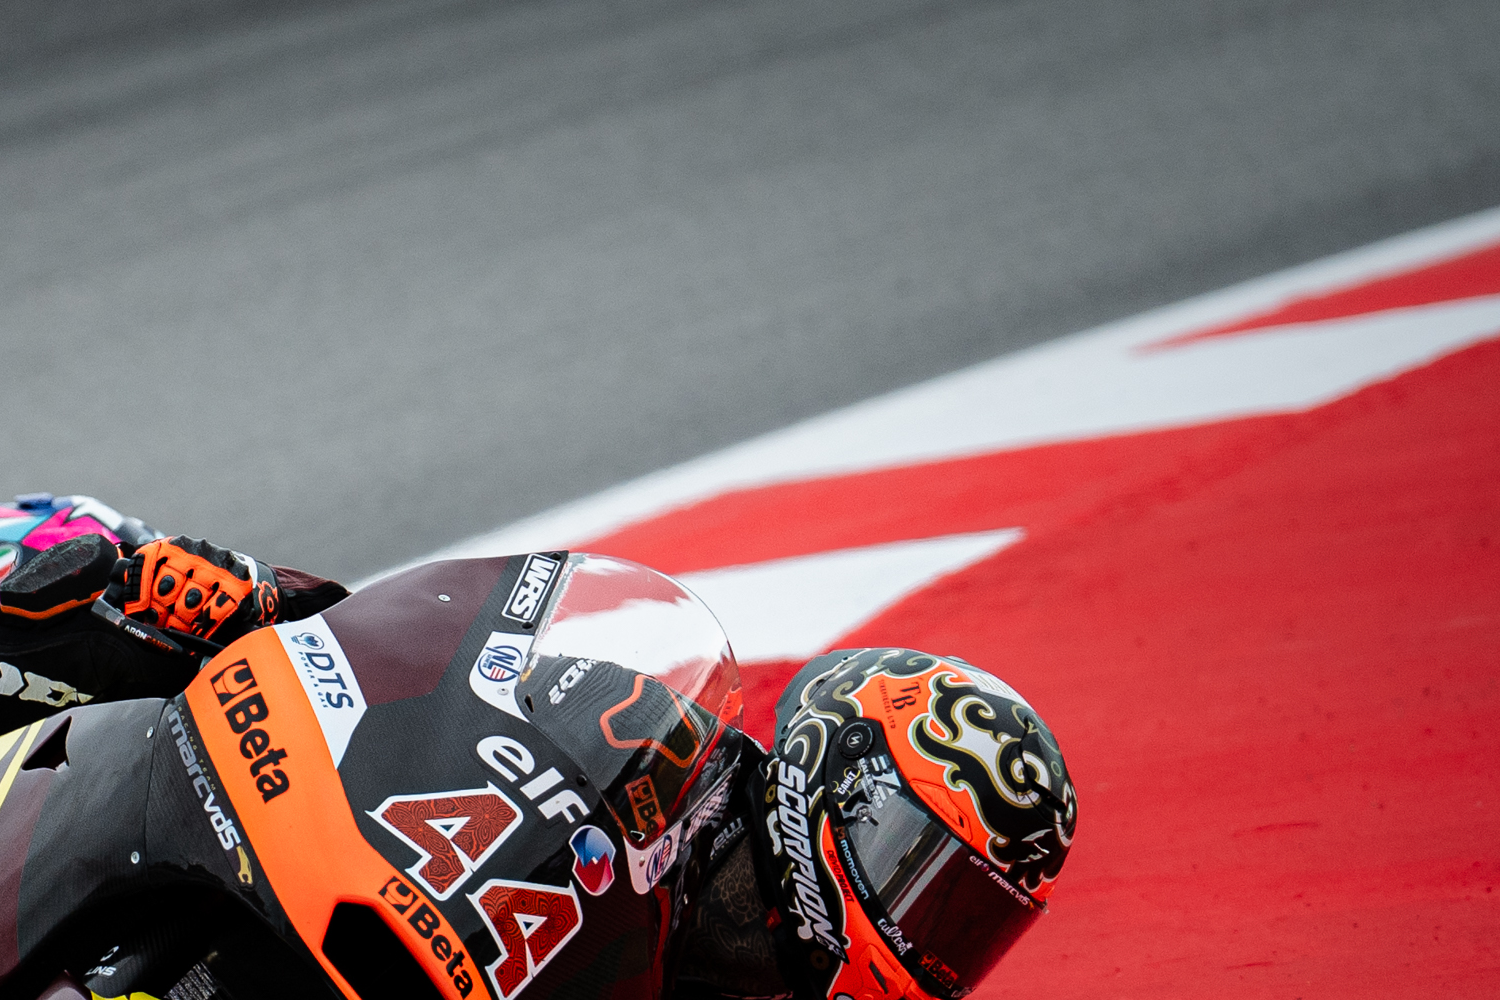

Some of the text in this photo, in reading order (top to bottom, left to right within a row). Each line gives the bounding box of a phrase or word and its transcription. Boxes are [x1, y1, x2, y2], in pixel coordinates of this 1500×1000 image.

[510, 558, 555, 619] WRS
[298, 652, 315, 681] POWER
[318, 692, 329, 708] GAS
[304, 652, 354, 709] DTS
[892, 681, 921, 709] TB
[178, 706, 216, 791] RACING TEAM
[225, 692, 290, 804] Beta
[476, 736, 589, 825] elf
[837, 770, 857, 795] CANET
[777, 760, 840, 950] SCORPION
[840, 840, 869, 900] momoven
[969, 855, 983, 868] elf
[407, 906, 474, 998] Beta
[929, 960, 955, 988] Beta
